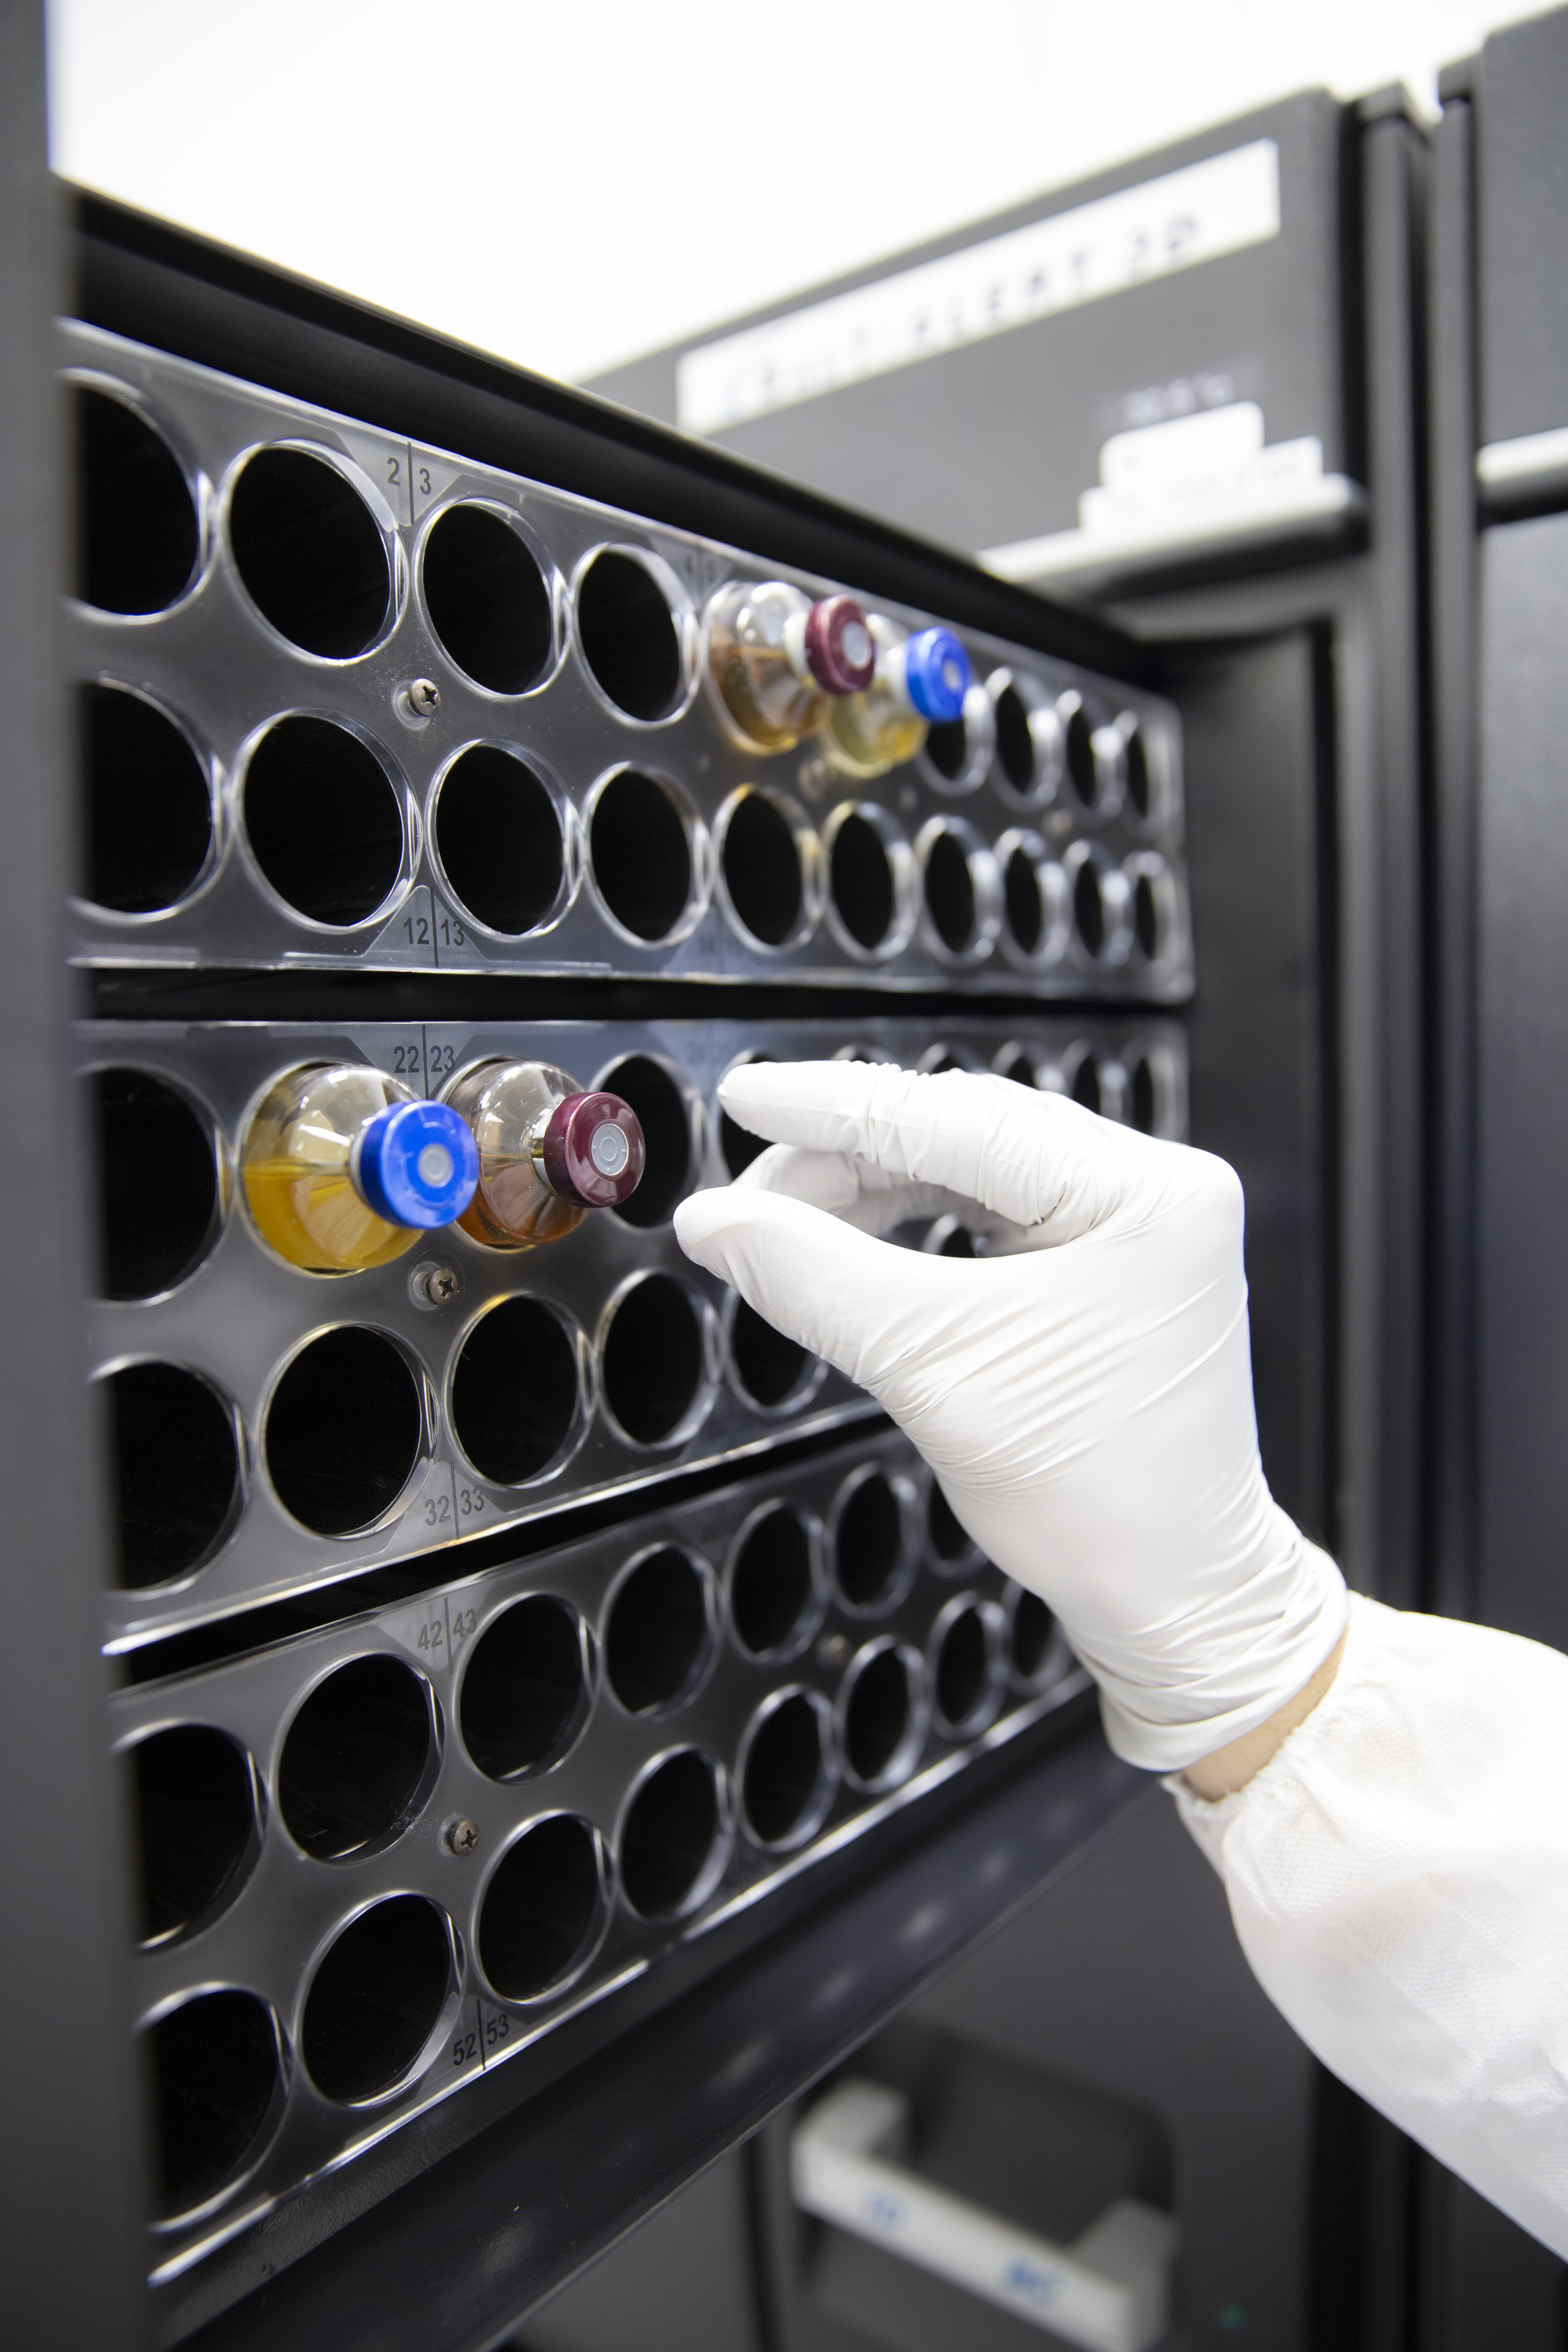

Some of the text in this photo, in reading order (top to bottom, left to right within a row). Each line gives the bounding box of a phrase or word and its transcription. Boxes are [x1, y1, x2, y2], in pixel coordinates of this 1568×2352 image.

[387, 457, 432, 495] 2 3
[403, 916, 465, 946] 12 13
[393, 1045, 455, 1073] 22 23
[424, 1485, 485, 1526] 32 33
[417, 1608, 478, 1650] 42 43
[453, 2013, 510, 2067] 52 53
